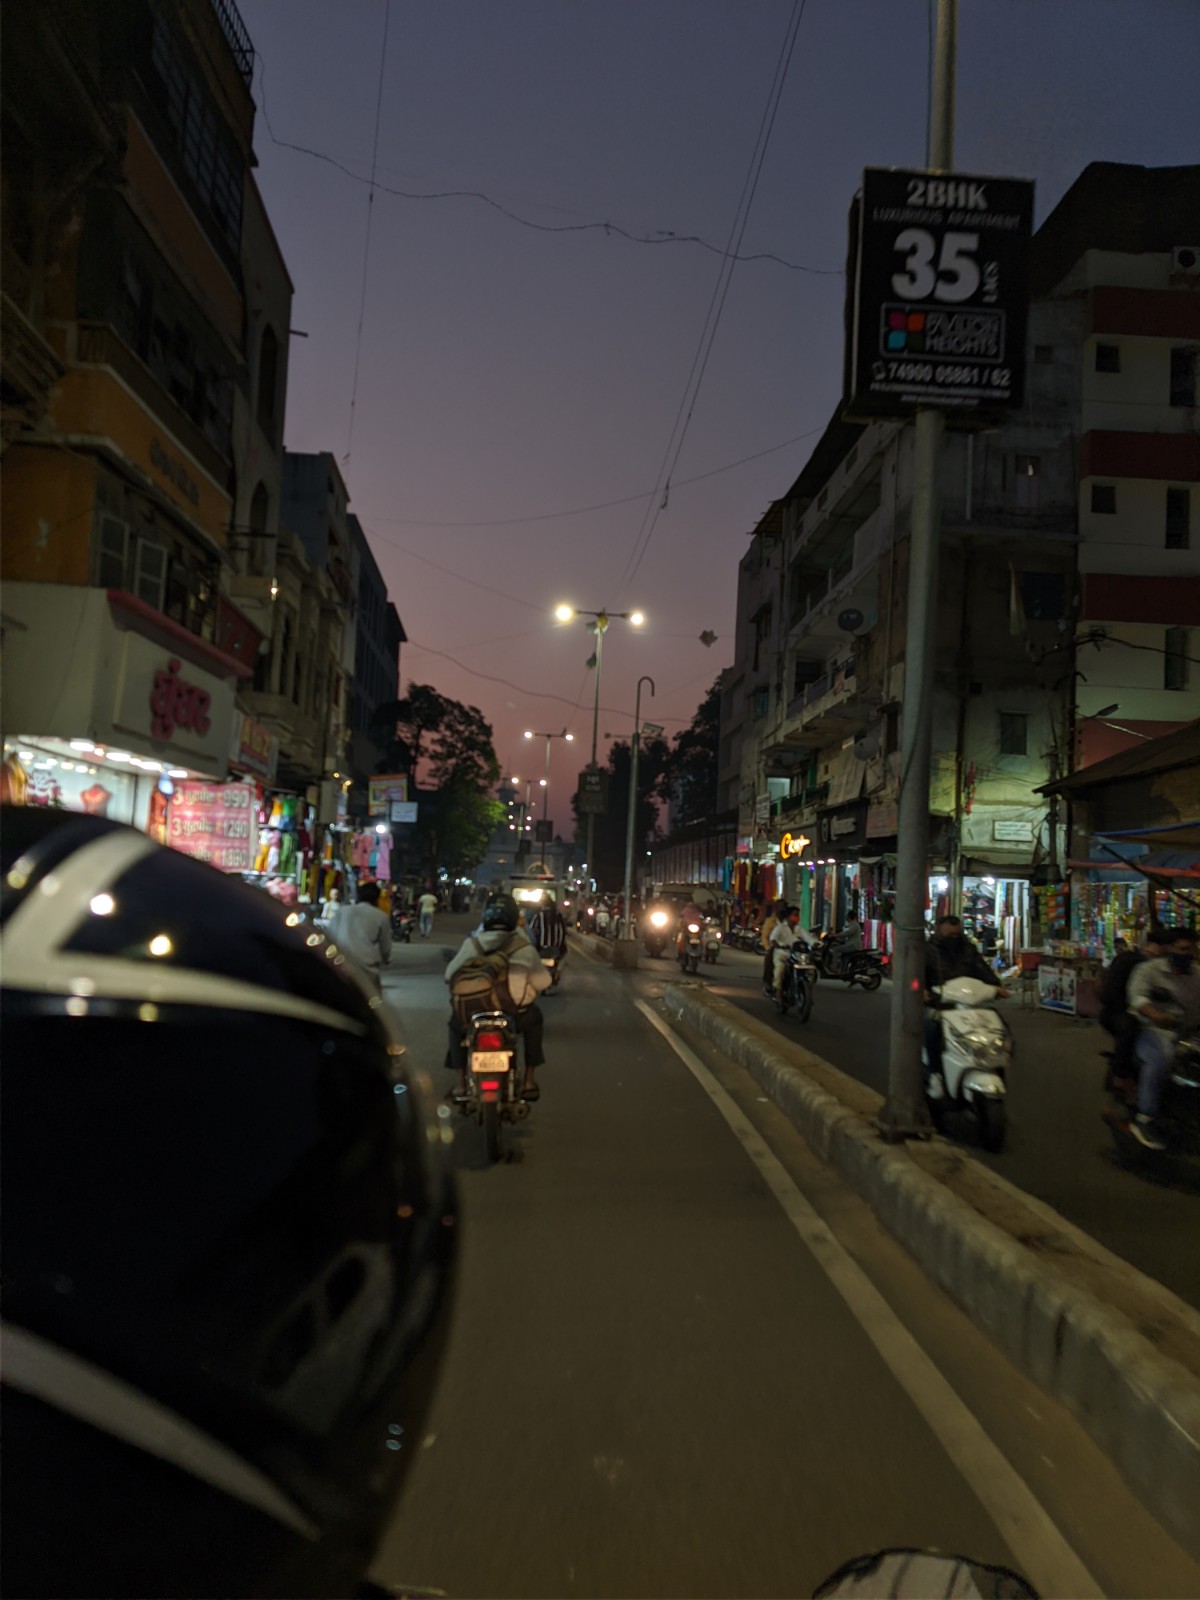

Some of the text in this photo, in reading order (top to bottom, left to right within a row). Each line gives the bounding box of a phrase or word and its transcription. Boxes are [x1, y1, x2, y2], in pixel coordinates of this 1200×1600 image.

[906, 178, 989, 211] 2BHK
[890, 226, 981, 304] 35
[926, 333, 999, 356] HEIGHTS
[172, 786, 184, 806] 3
[171, 816, 182, 837] 3
